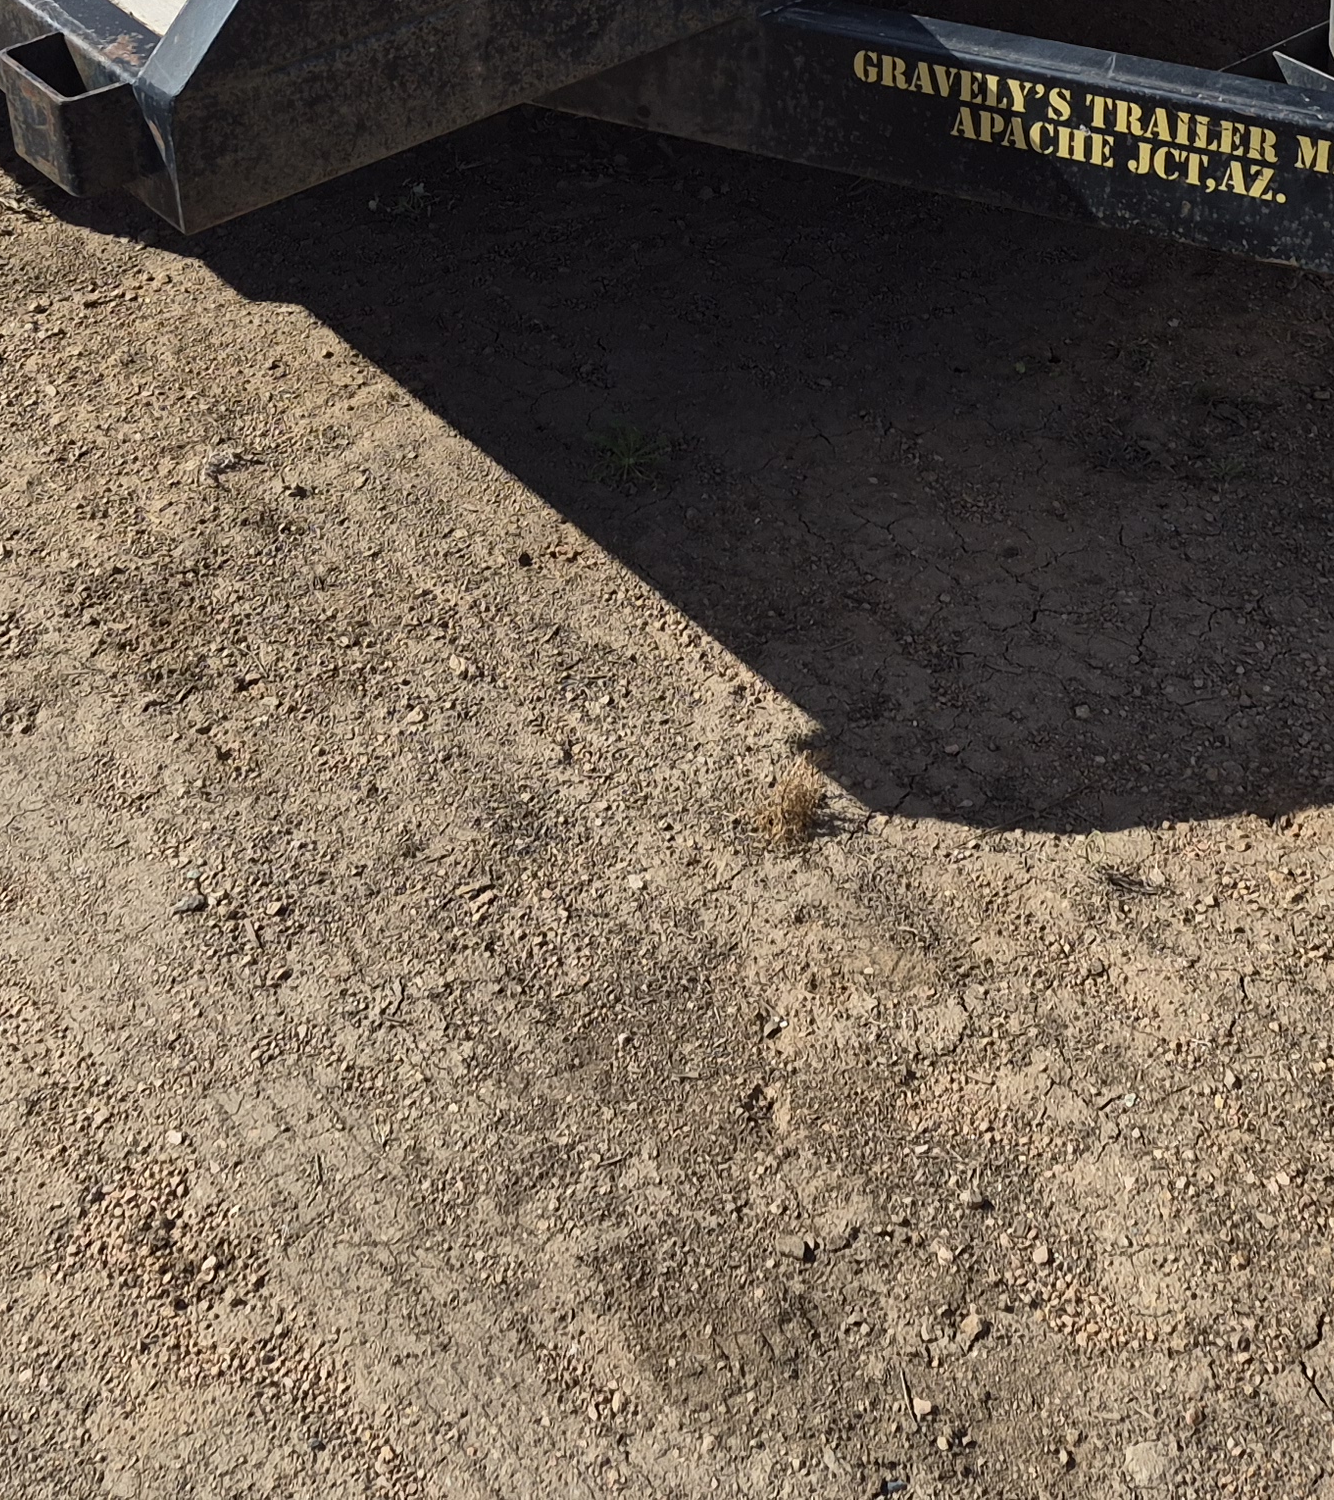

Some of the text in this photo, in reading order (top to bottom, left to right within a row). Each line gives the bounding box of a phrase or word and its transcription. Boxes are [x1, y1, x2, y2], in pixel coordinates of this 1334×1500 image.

[853, 50, 1071, 121] GRAVELY'S
[1085, 93, 1279, 163] TRAILER
[950, 107, 1115, 168] APACHE
